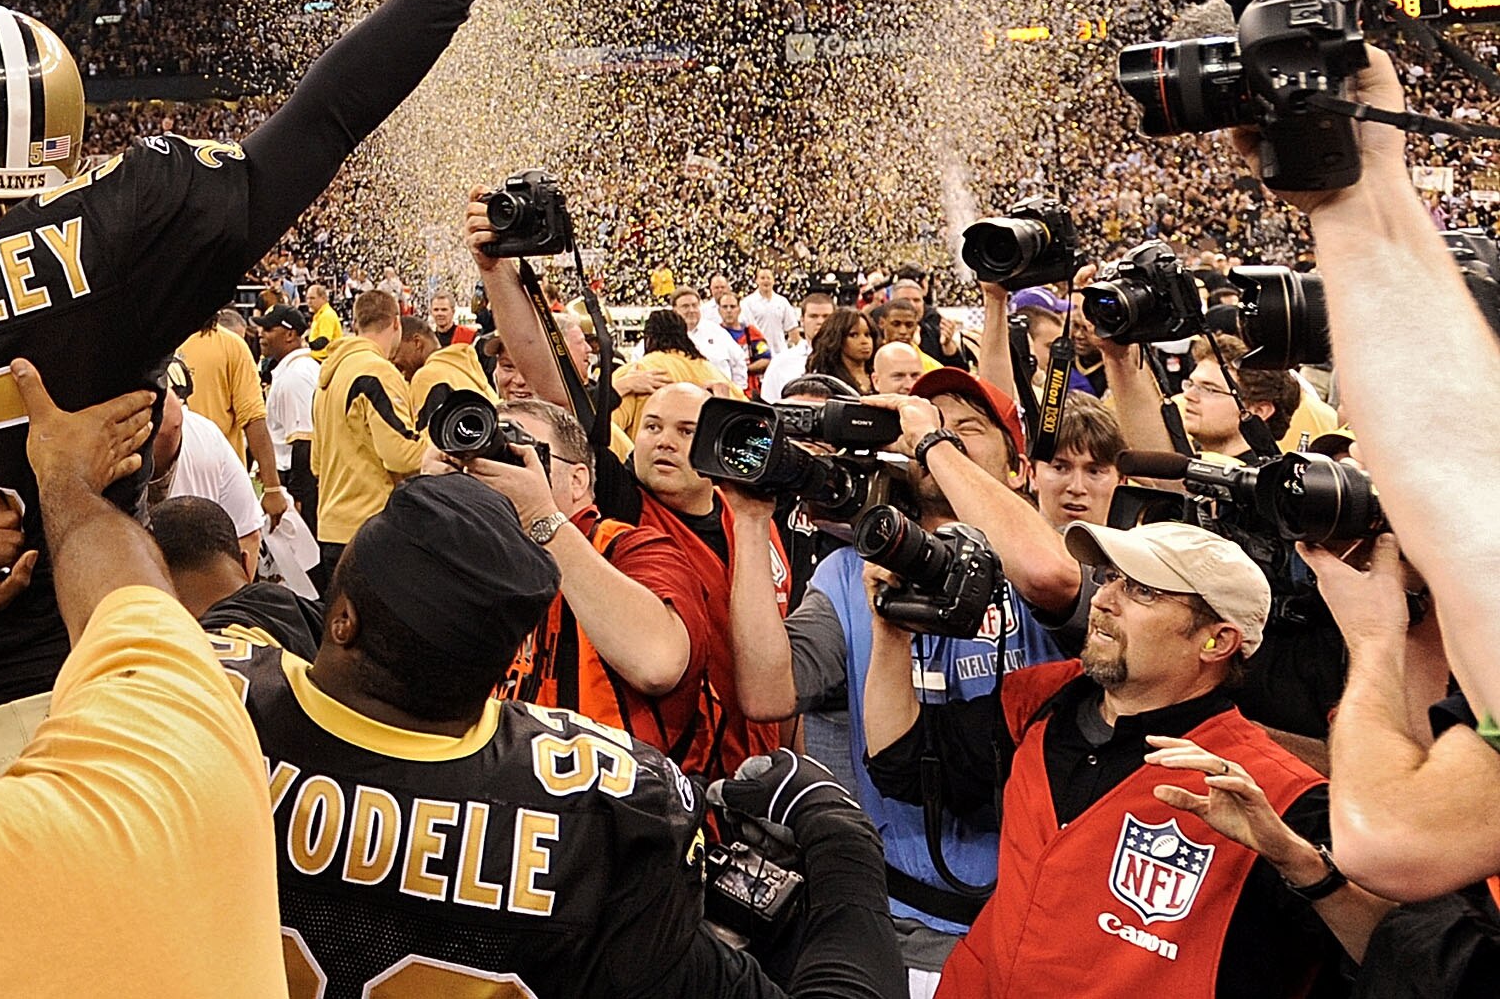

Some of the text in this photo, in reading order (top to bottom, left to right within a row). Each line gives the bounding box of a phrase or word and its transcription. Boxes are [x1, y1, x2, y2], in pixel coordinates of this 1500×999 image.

[29, 141, 43, 165] 5
[1047, 368, 1064, 405] Nikon
[956, 654, 989, 680] NFL
[1120, 852, 1187, 909] NFL
[1097, 912, 1179, 962] Canon
